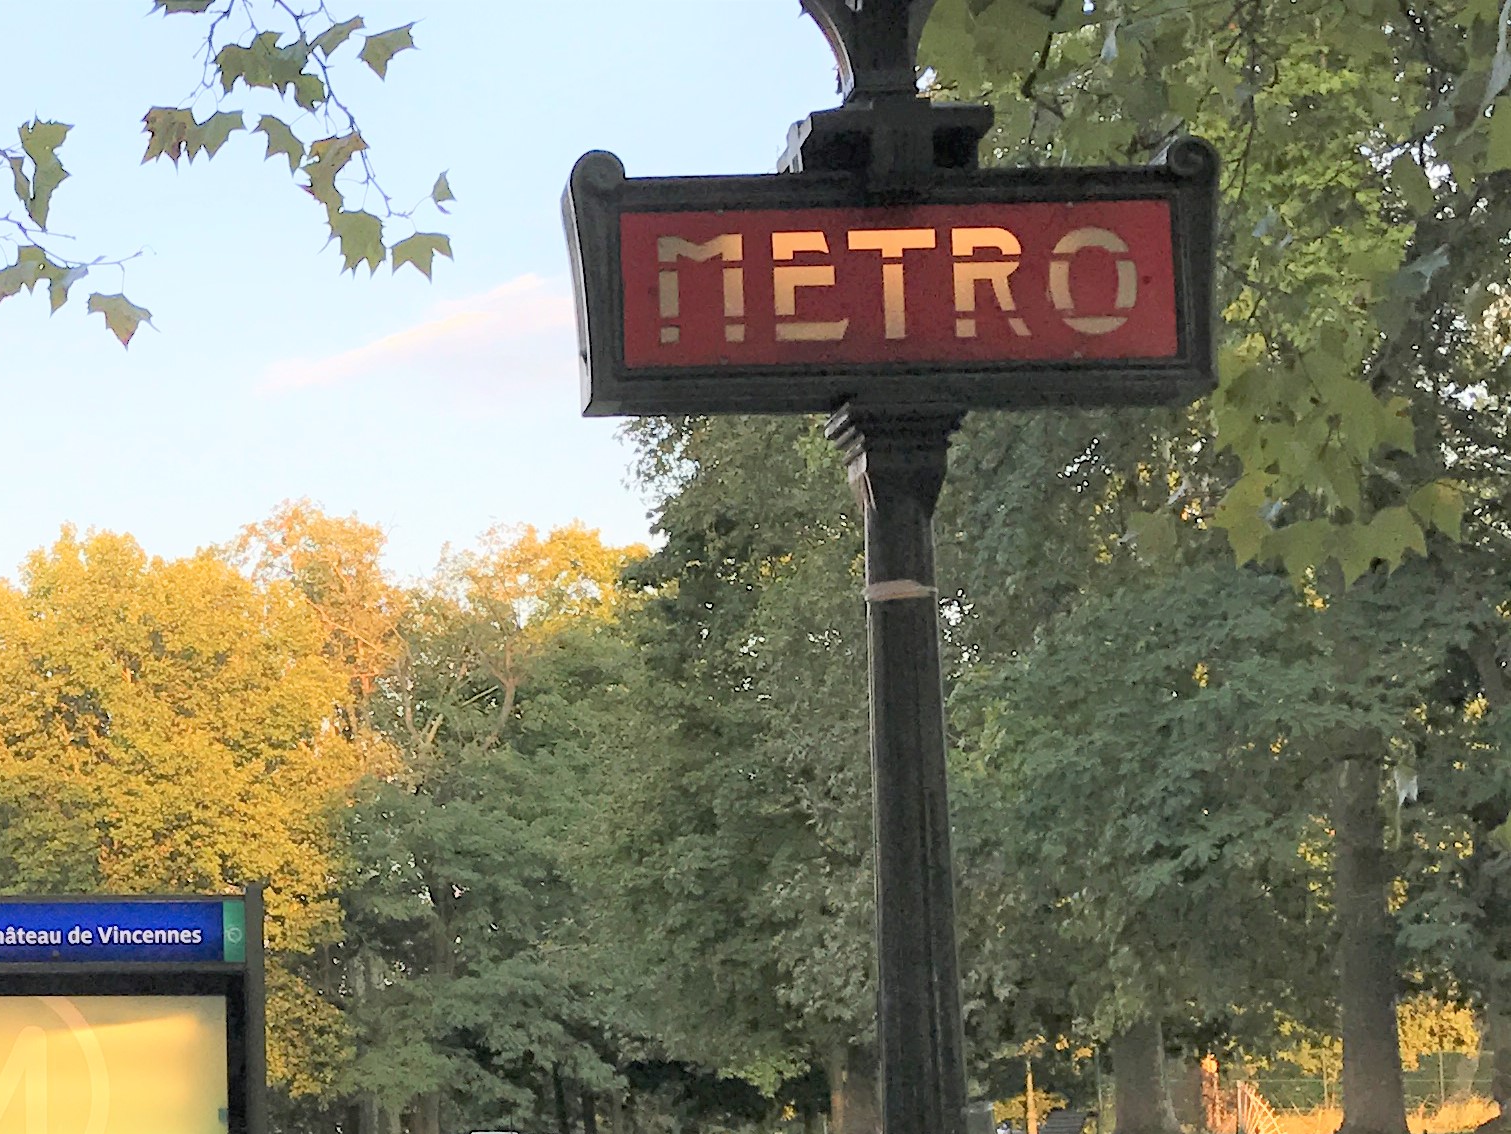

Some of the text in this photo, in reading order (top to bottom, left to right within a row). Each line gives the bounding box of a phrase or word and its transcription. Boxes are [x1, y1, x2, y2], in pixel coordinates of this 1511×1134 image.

[657, 227, 1138, 342] METRO
[68, 926, 93, 945] de
[100, 926, 202, 945] Vincennes
